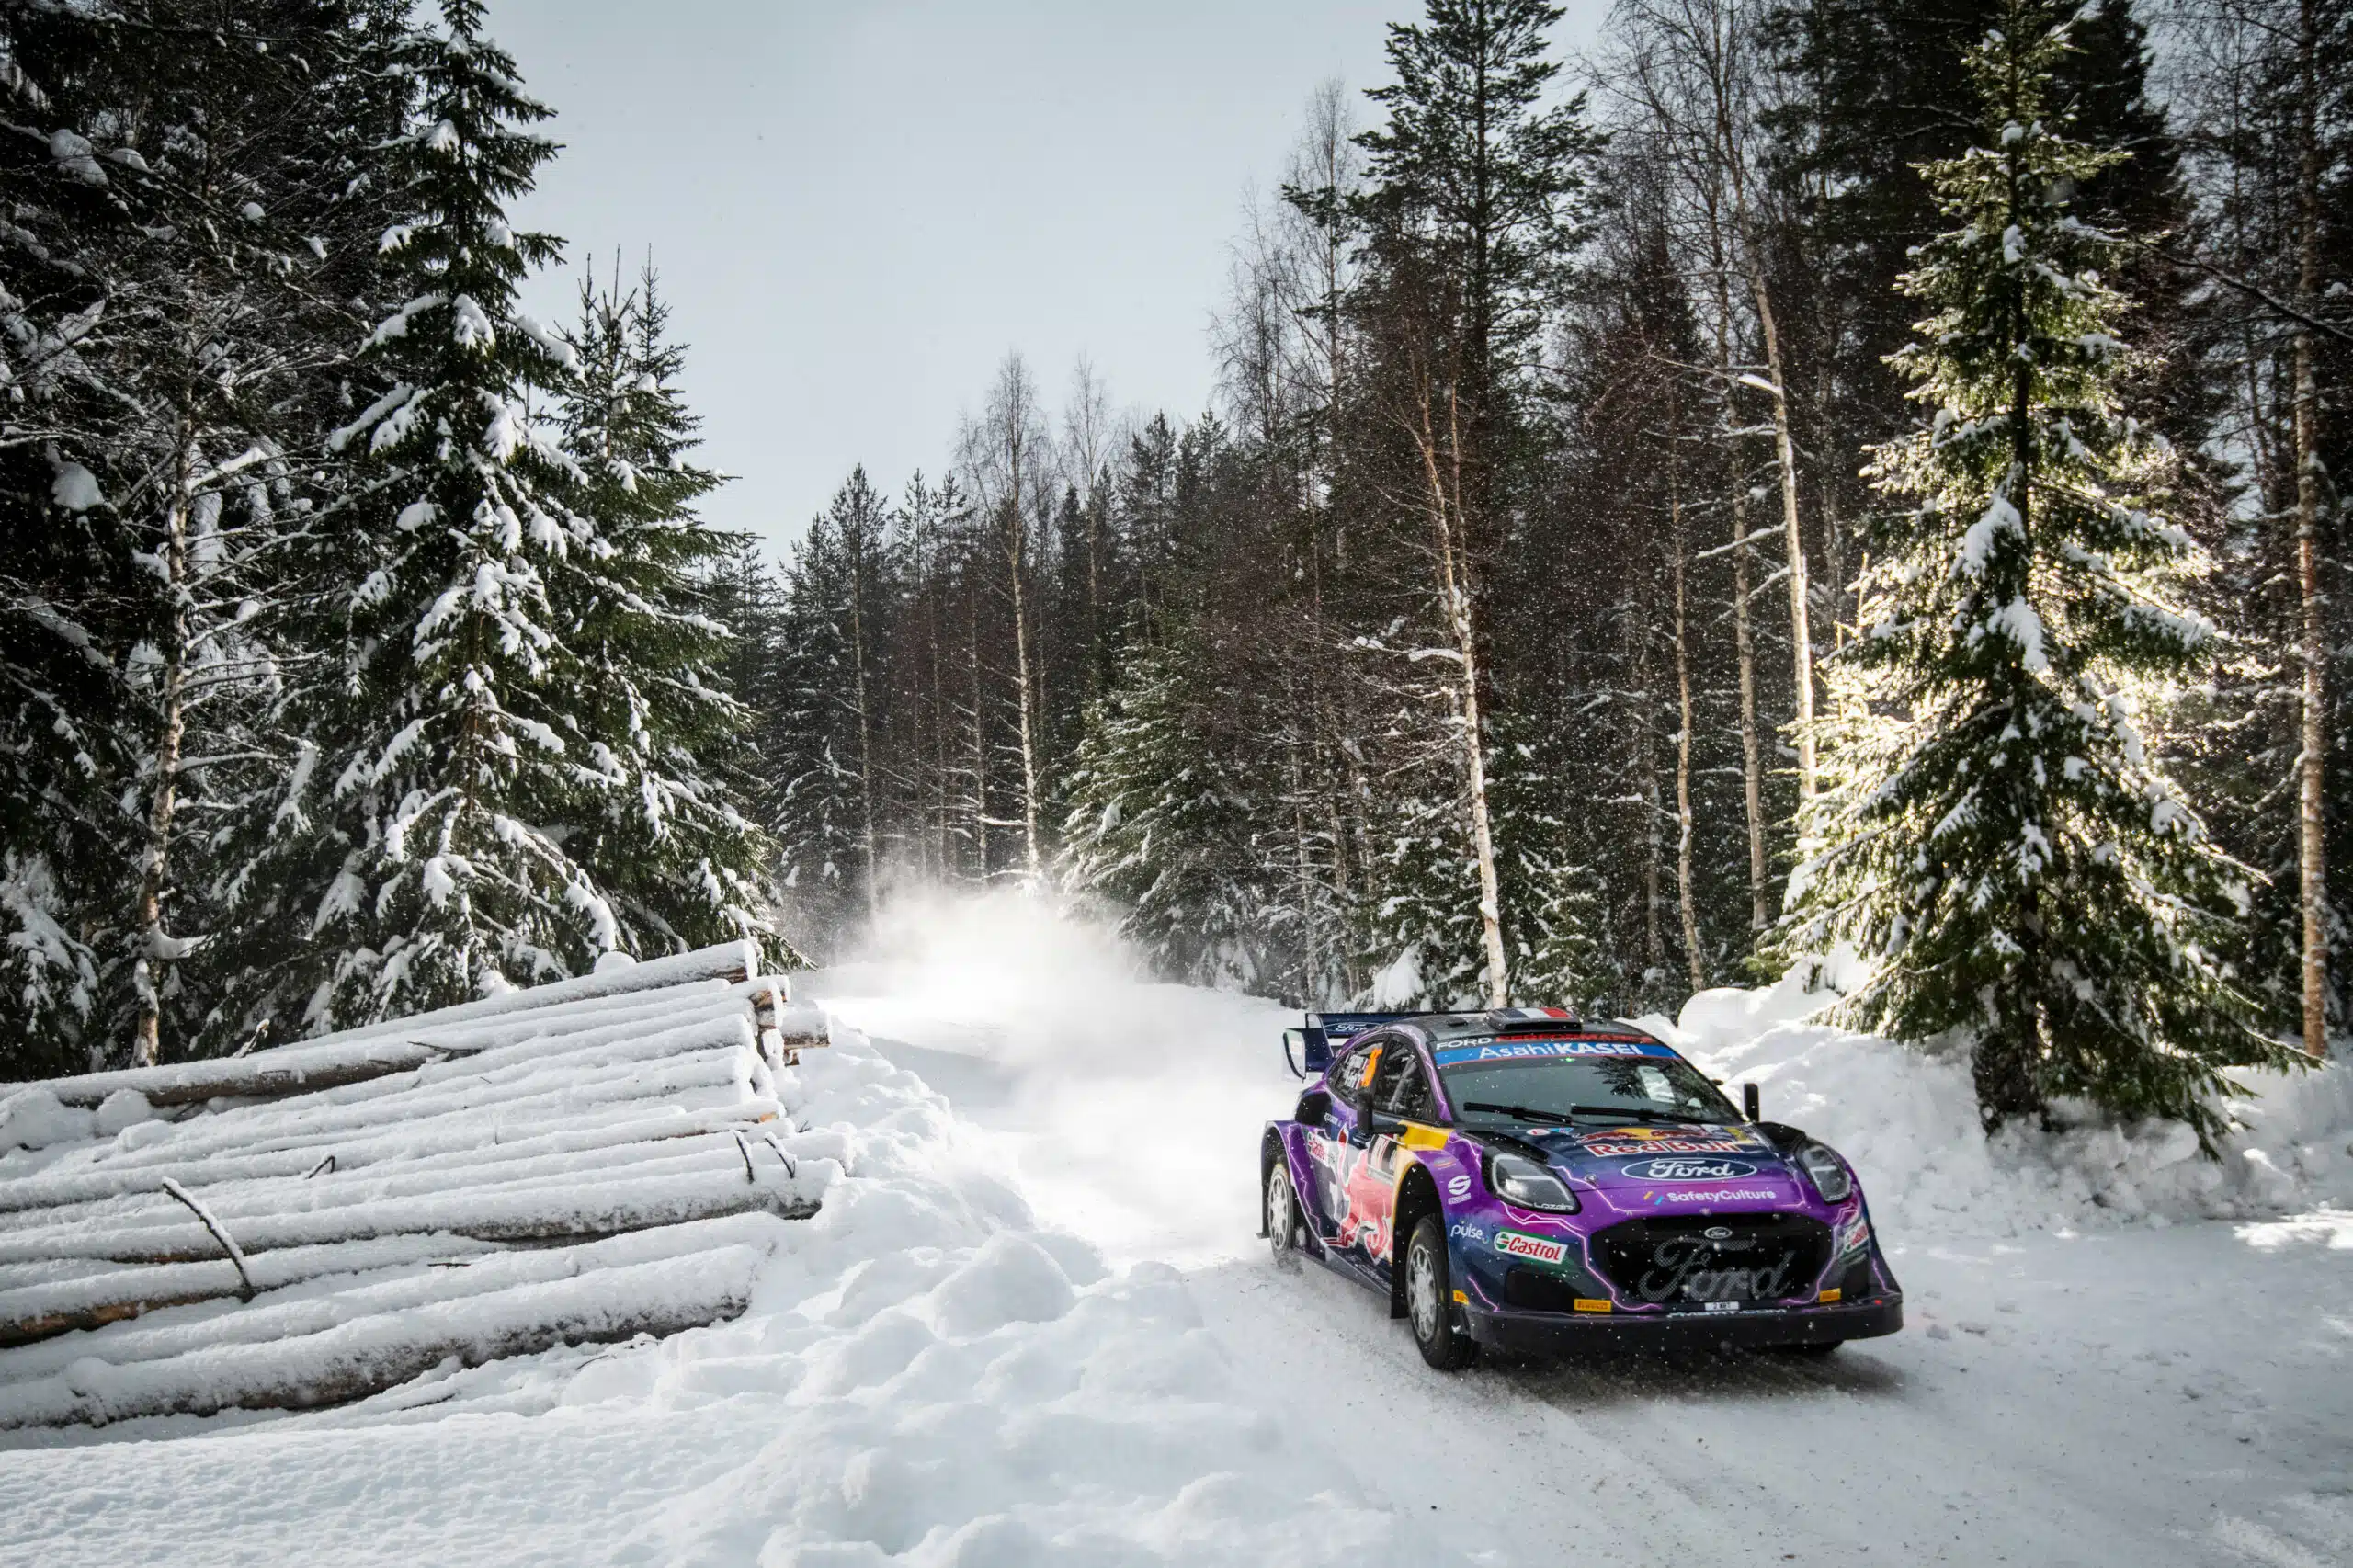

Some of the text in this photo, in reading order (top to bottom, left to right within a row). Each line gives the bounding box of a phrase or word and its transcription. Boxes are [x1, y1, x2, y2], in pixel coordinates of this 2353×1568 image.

[1436, 1036, 1492, 1051] FORD
[1585, 1140, 1744, 1158] Red Bull
[1647, 1158, 1735, 1178] Ford
[1666, 1187, 1776, 1203] SafetyCulture
[1450, 1223, 1483, 1240] pulse
[1508, 1236, 1563, 1261] Castrol
[1638, 1237, 1797, 1301] Ford
